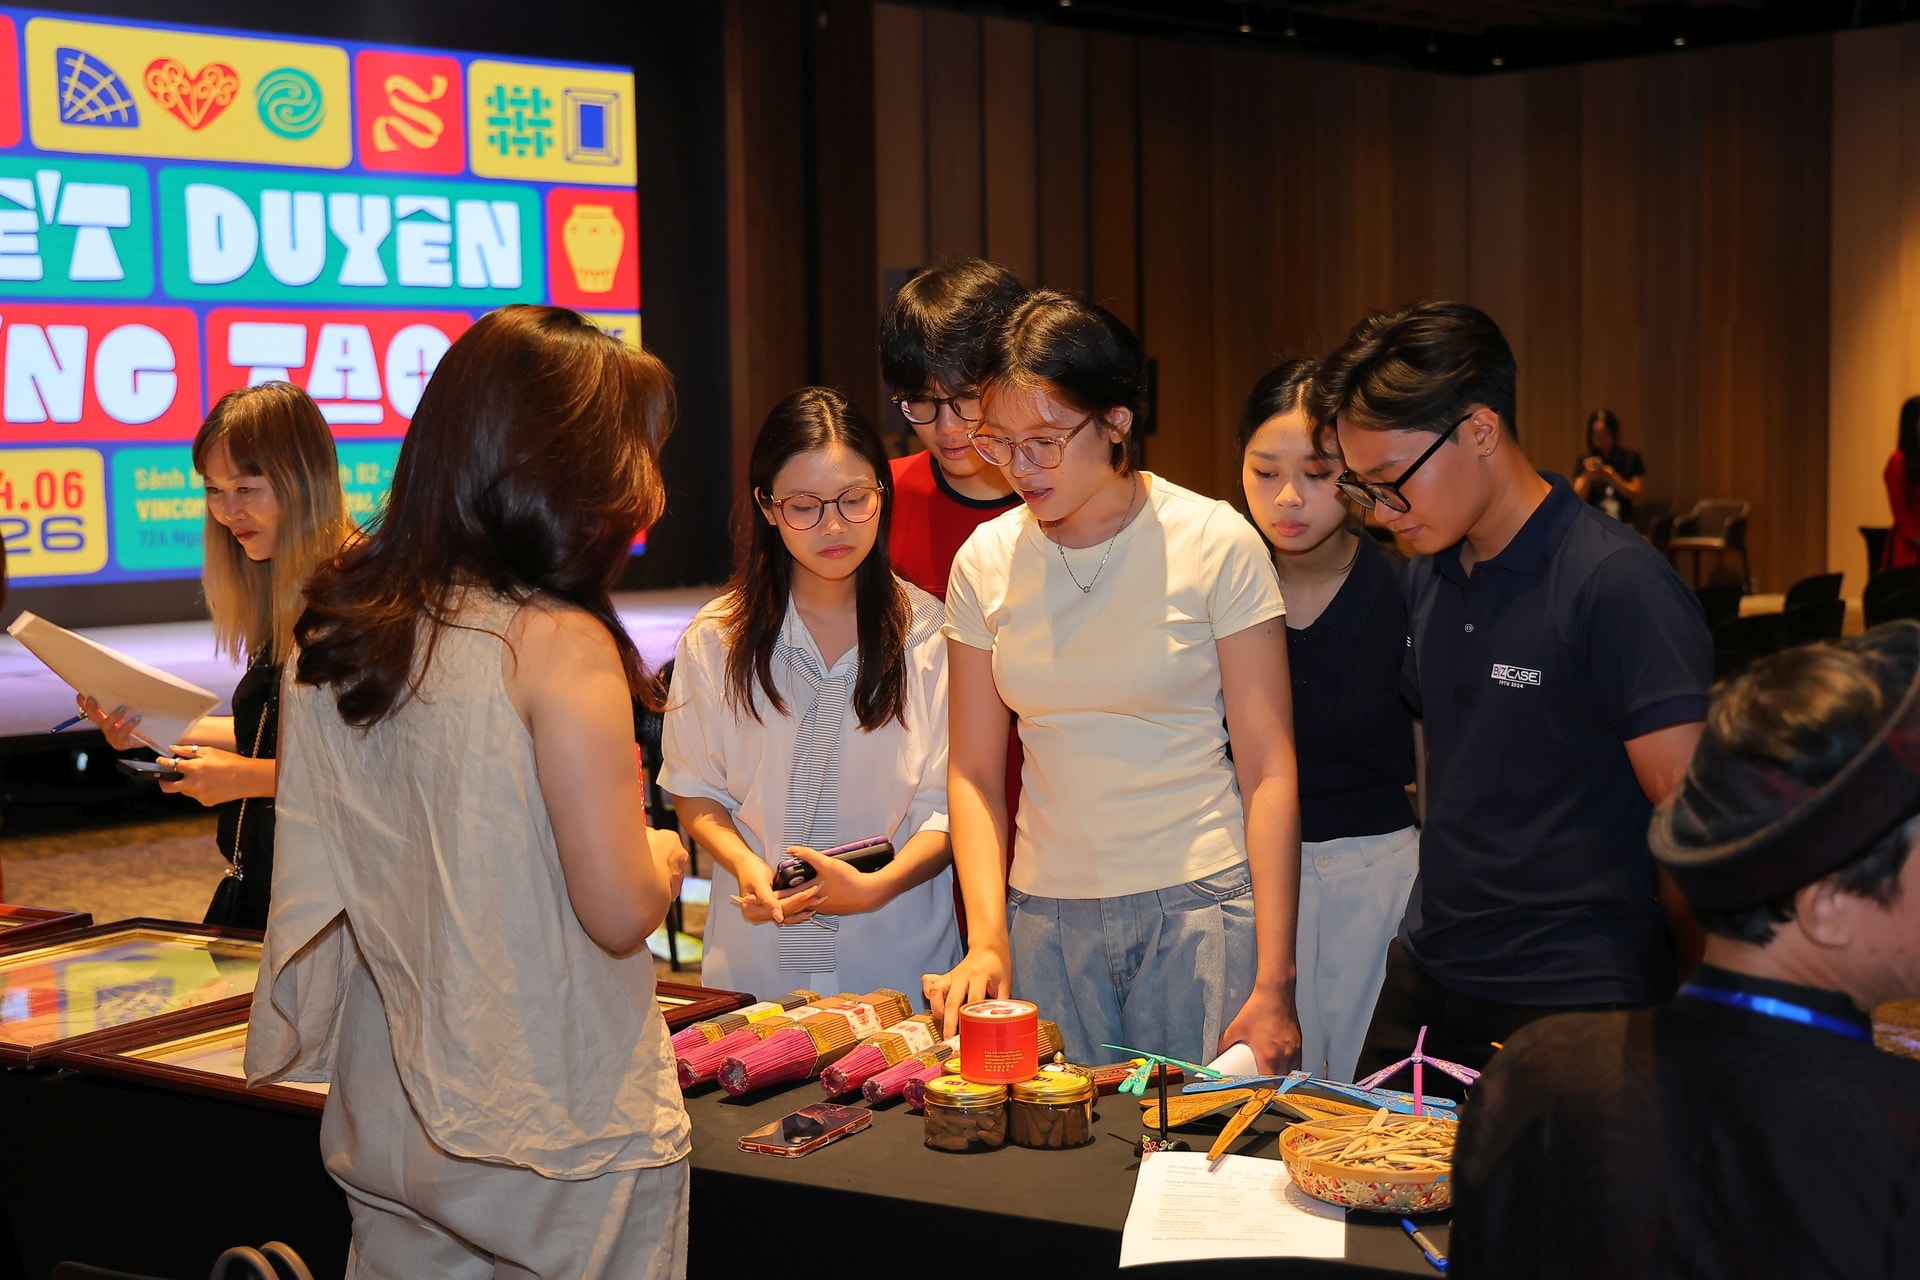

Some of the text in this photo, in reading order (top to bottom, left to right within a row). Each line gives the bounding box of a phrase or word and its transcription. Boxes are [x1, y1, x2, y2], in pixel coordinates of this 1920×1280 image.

[184, 182, 522, 290] DUYÊN
[0, 314, 453, 426] NG TẠO
